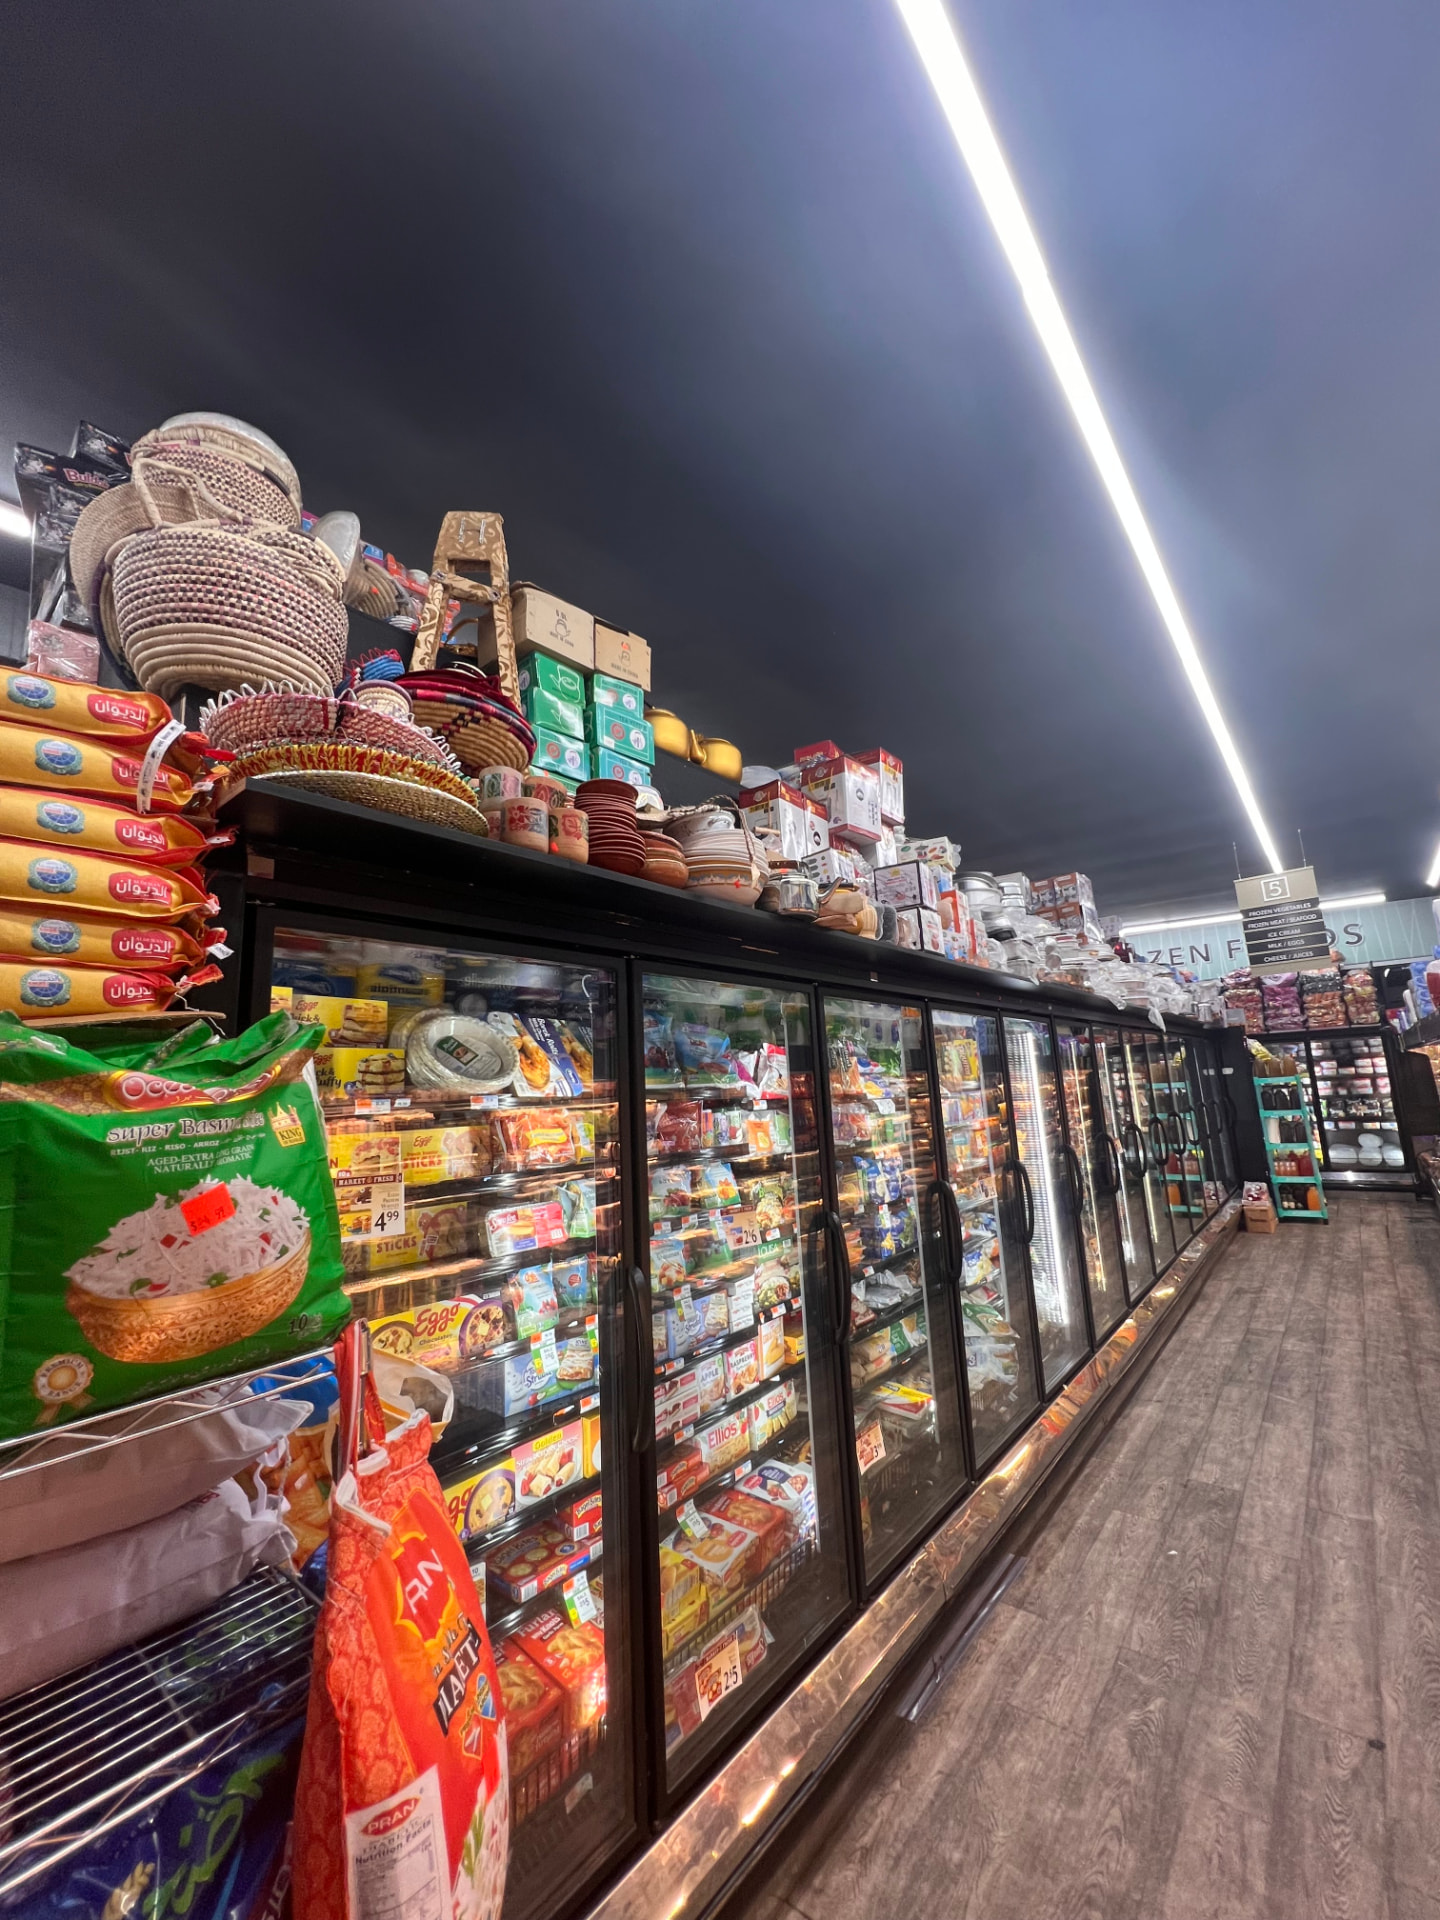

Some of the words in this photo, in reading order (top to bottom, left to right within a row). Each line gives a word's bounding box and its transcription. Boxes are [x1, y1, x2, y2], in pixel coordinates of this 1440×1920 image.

[95, 699, 146, 722] الديوان
[122, 824, 165, 846] الديوان
[116, 878, 167, 898] الديوان
[1269, 880, 1282, 897] 5
[1249, 909, 1273, 917] FROZEN
[1274, 902, 1312, 913] VEGETABLES
[1248, 921, 1269, 929] FROZEN
[1270, 918, 1285, 926] MEAT
[1290, 913, 1317, 922] SEAFOOD
[1279, 928, 1301, 936] CREAM
[119, 937, 171, 954] الديوان
[1287, 939, 1305, 947] EGGS
[1263, 954, 1287, 963] CHEESE
[1292, 950, 1314, 959] JUICES
[278, 1127, 302, 1141] KING
[193, 1140, 220, 1148] ARROZ
[338, 1177, 366, 1187] MARKET
[373, 1175, 395, 1184] FRESH
[376, 1235, 417, 1254] STICKS
[413, 1302, 462, 1338] Eggo
[700, 1367, 719, 1382] APPLE
[534, 1431, 563, 1451] Golden
[367, 1798, 417, 1834] PRAN
[355, 1842, 404, 1865] Nutrition
[405, 1819, 432, 1843] Facts
